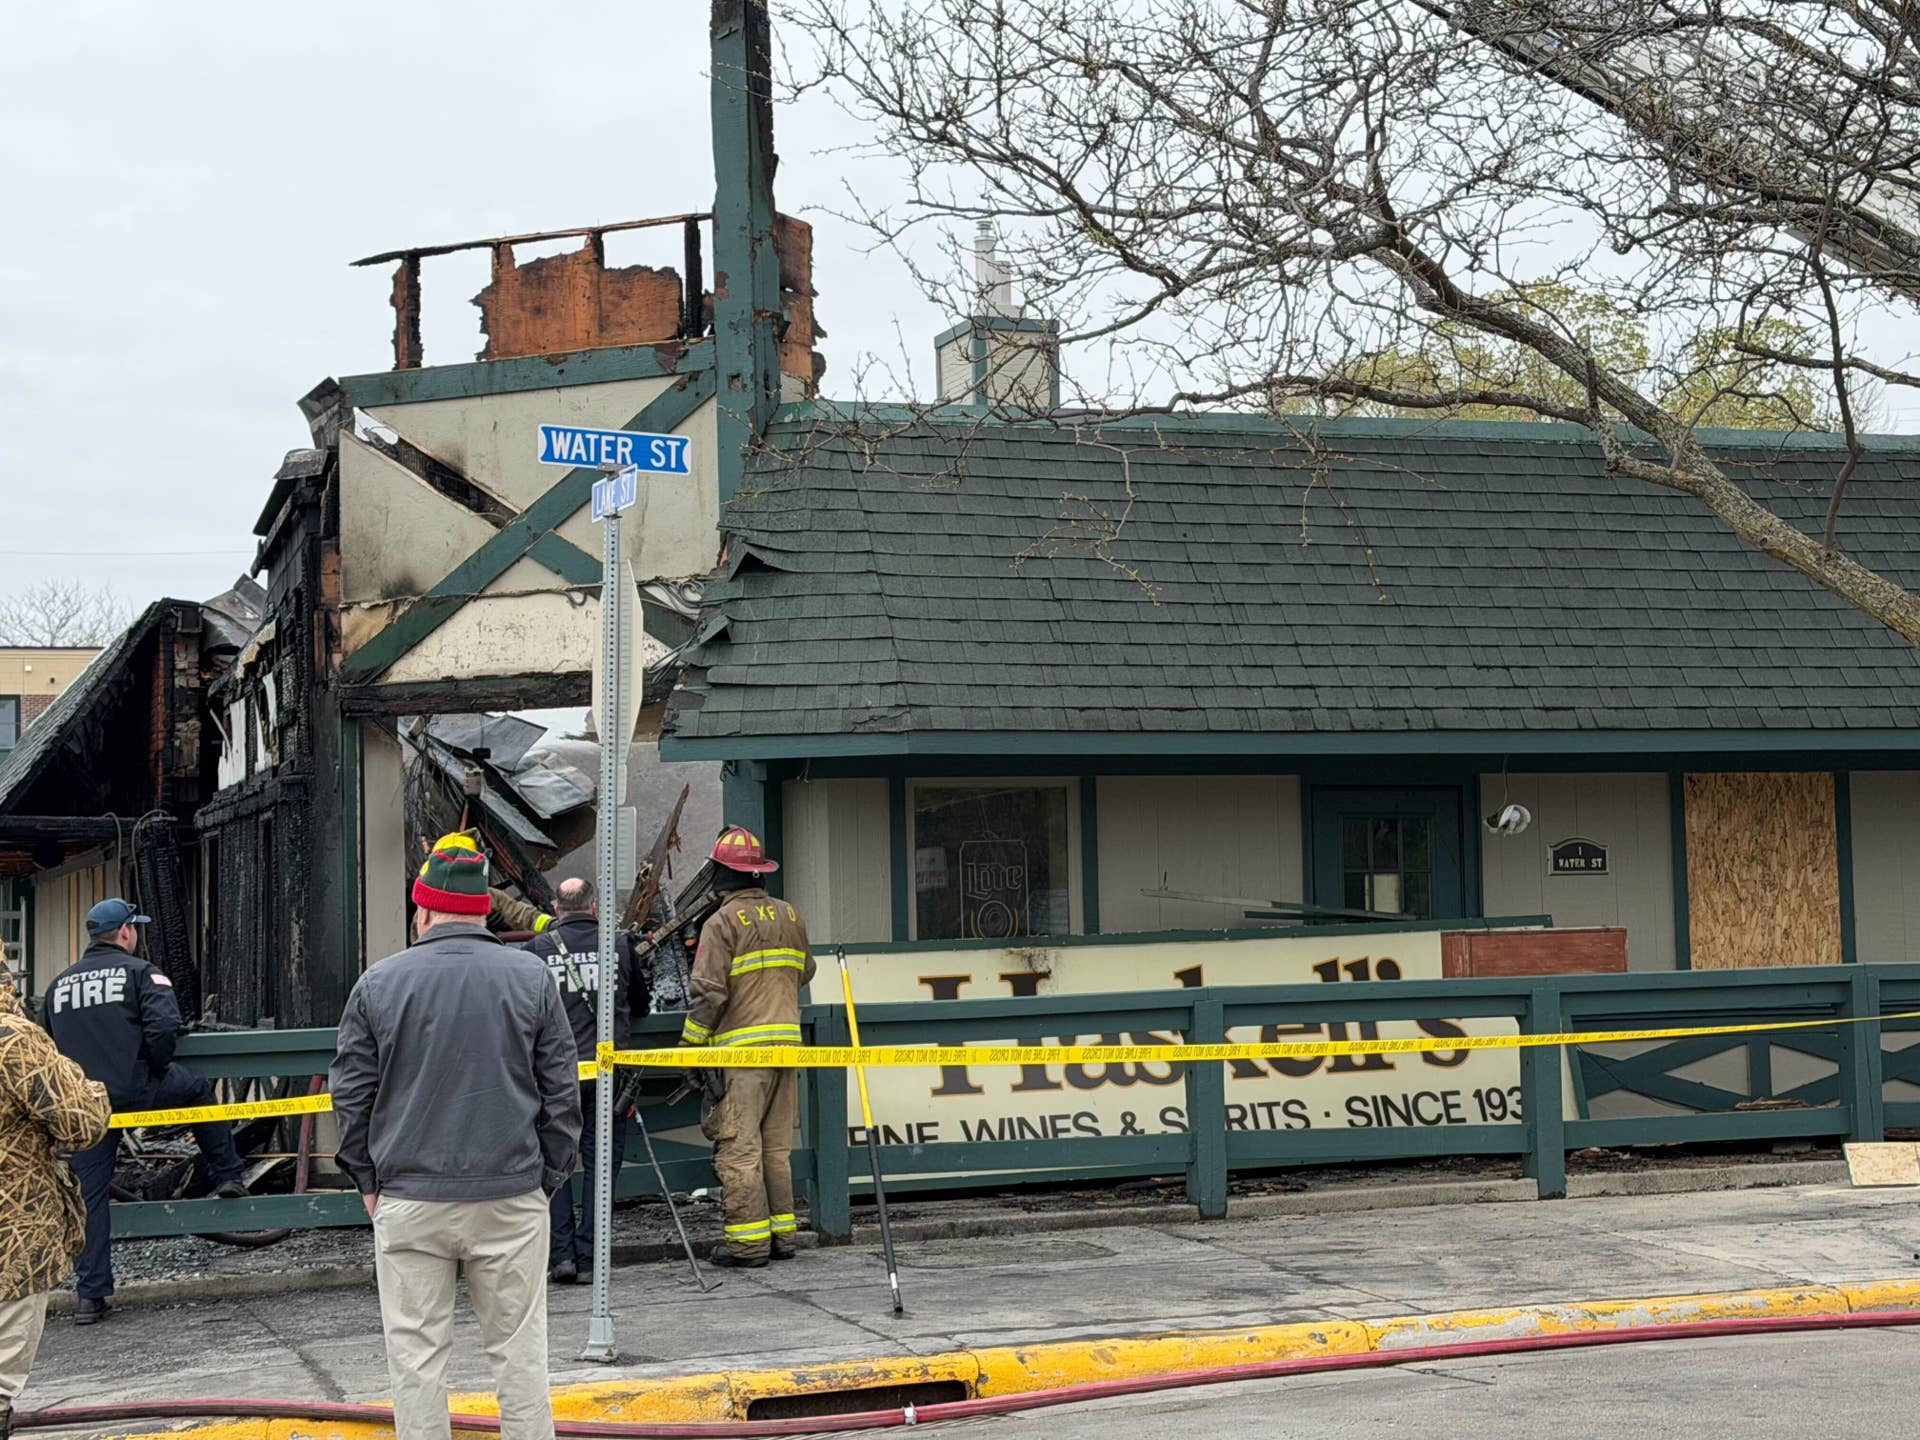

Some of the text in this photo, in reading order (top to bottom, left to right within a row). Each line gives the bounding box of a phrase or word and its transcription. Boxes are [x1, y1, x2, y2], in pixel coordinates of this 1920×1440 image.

[551, 431, 681, 468] WATER ST
[620, 472, 633, 505] ST
[1558, 858, 1602, 868] WATER ST
[547, 952, 619, 966] EXELSR
[57, 967, 127, 987] VICTORIA
[53, 977, 127, 1014] FIRE
[960, 1111, 1102, 1142] WINES
[1120, 1111, 1145, 1136] &
[1159, 1099, 1312, 1134] SRITS
[1344, 1090, 1467, 1128] SINCE
